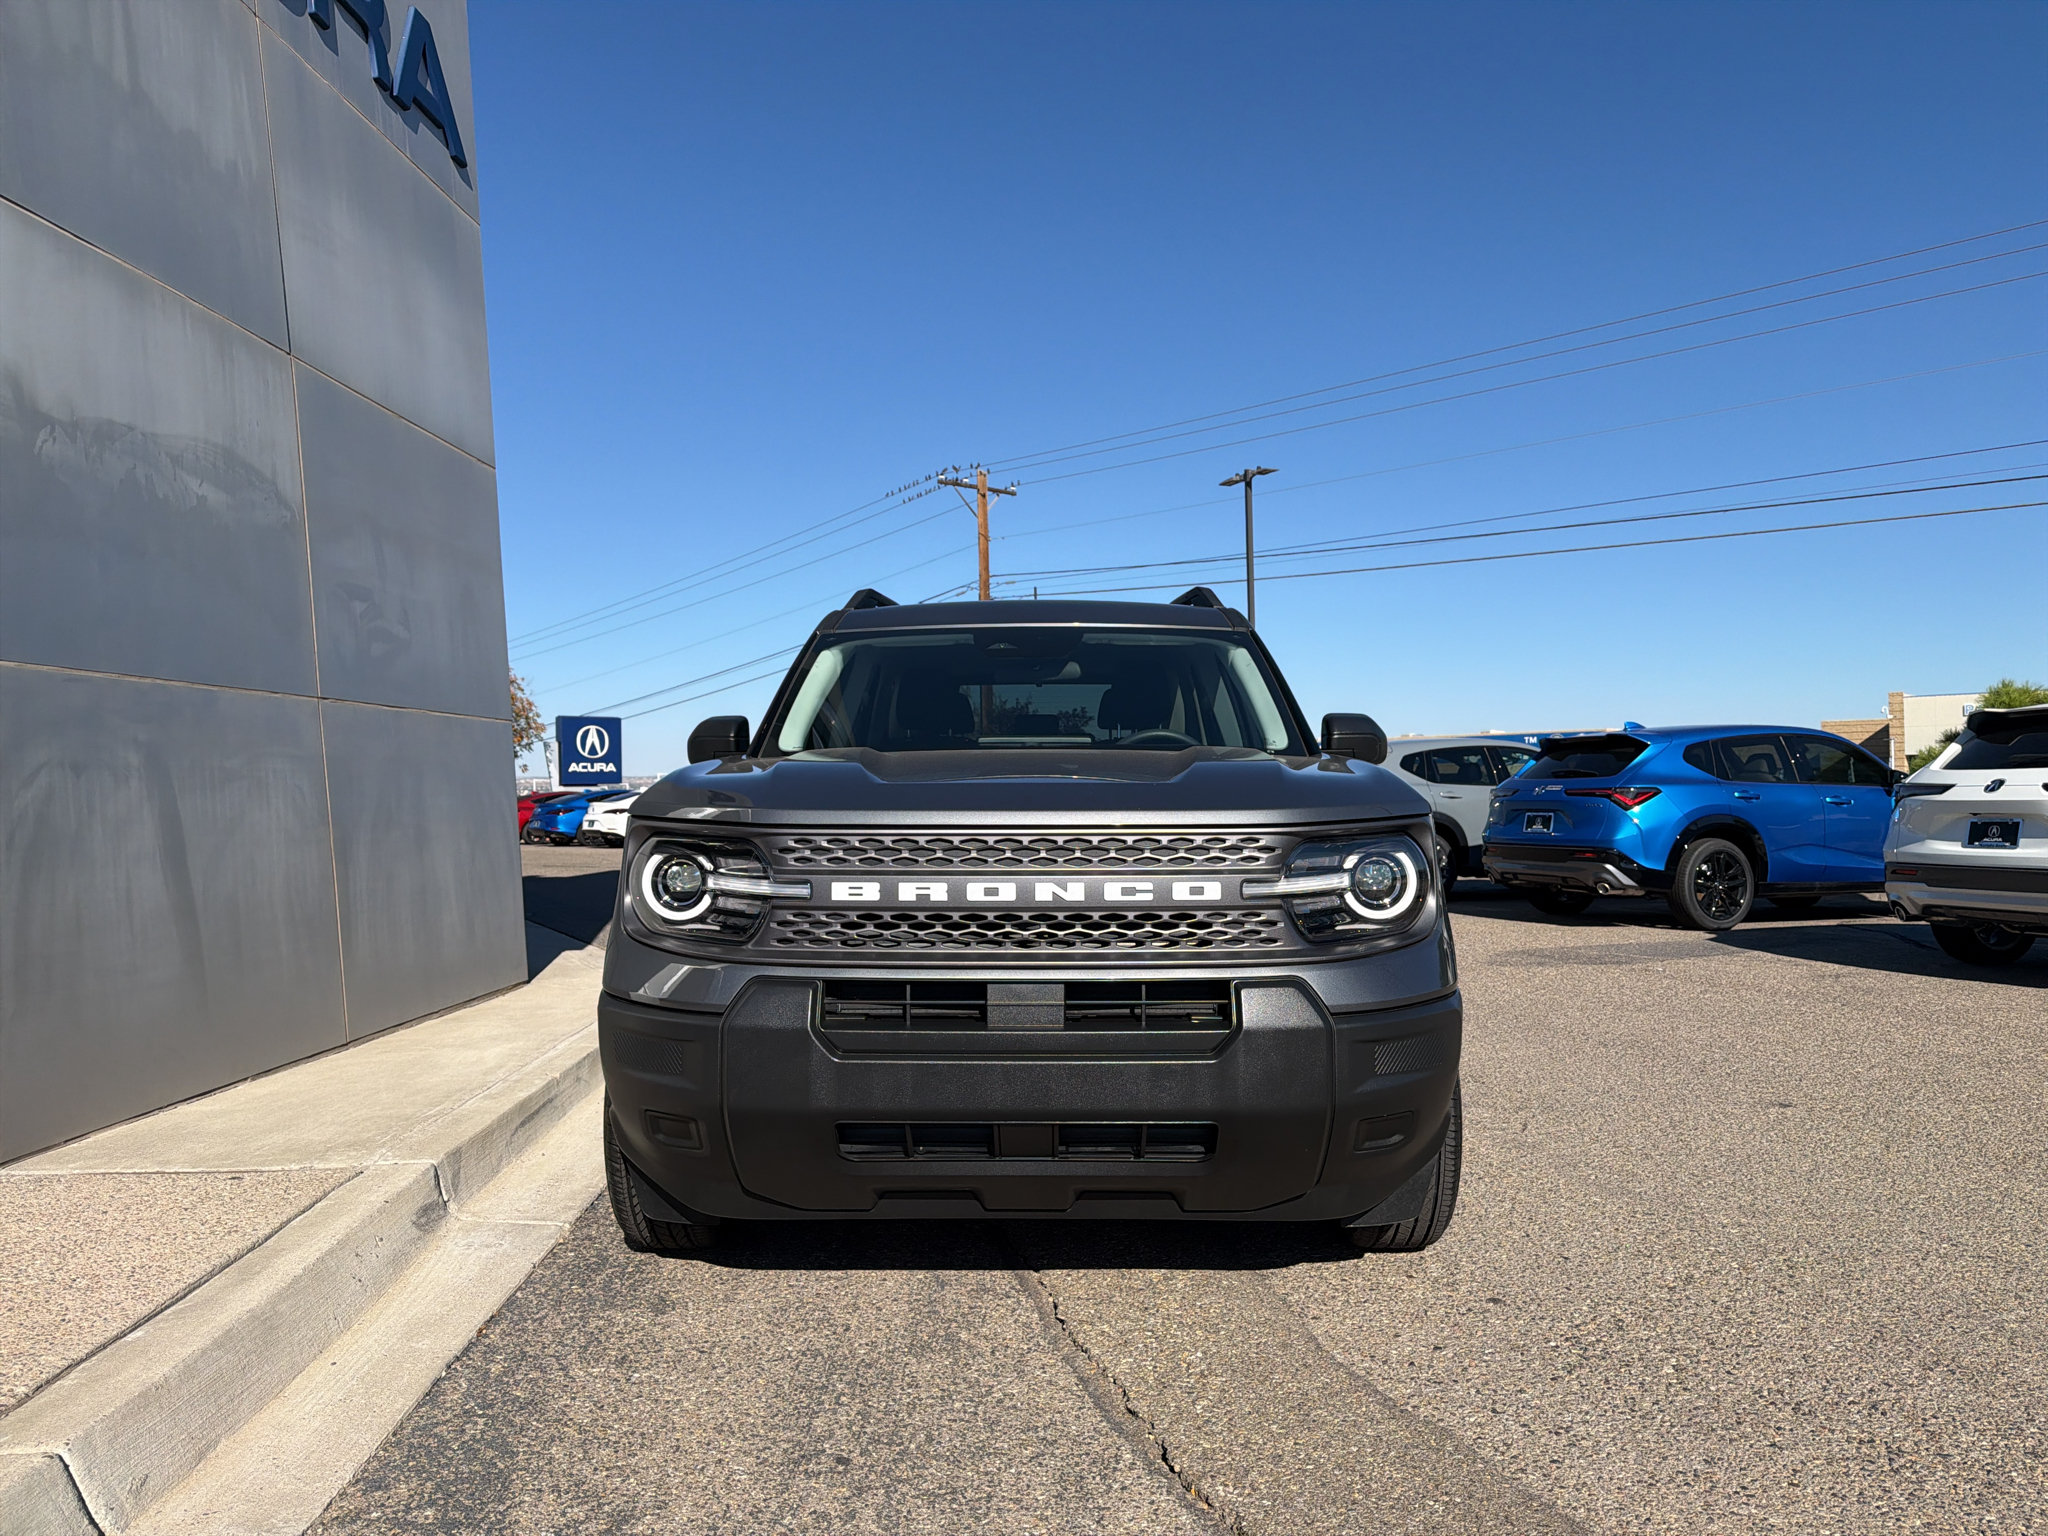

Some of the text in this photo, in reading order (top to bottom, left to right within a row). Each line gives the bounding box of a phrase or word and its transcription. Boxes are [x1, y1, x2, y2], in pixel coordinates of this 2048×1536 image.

[1523, 736, 1538, 744] TM
[568, 762, 617, 773] ACURA
[831, 881, 1222, 901] BRONCO
